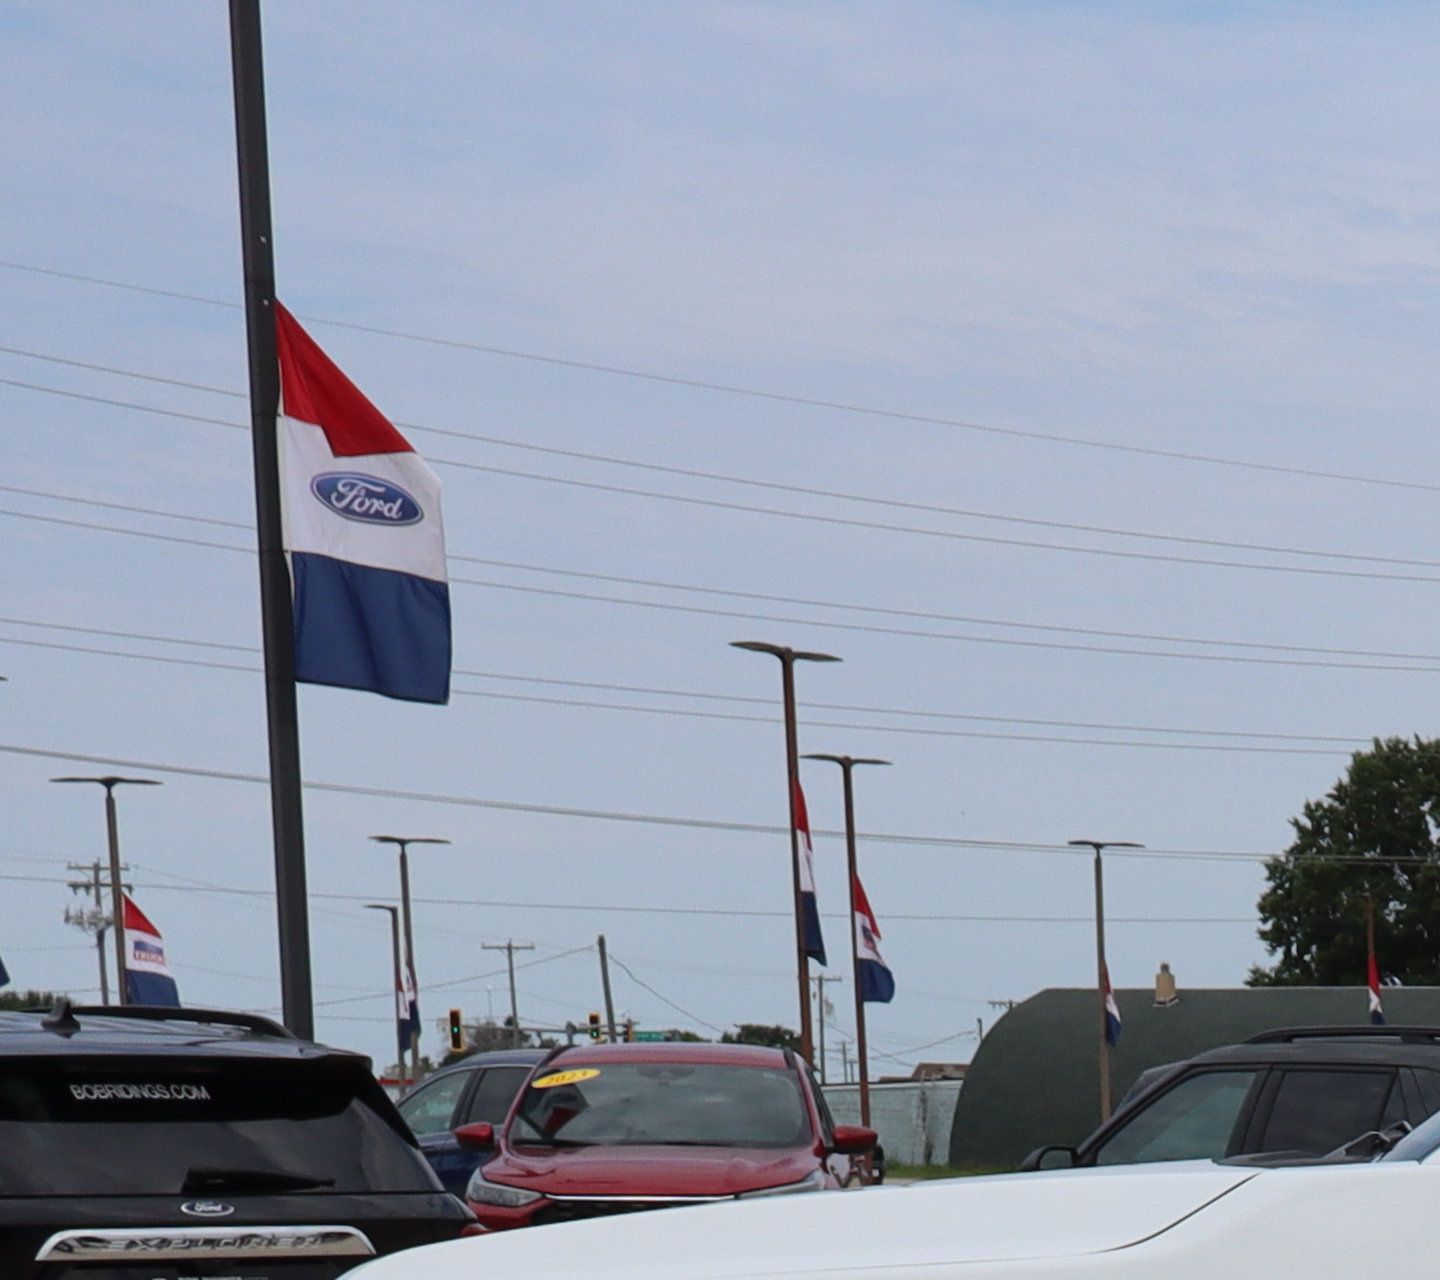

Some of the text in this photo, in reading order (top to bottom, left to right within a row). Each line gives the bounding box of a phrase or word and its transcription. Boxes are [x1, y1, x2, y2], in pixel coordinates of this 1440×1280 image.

[330, 478, 403, 520] Ford
[69, 1084, 212, 1100] BOBRIDINGS.COM
[103, 1236, 323, 1251] EXPLORER
